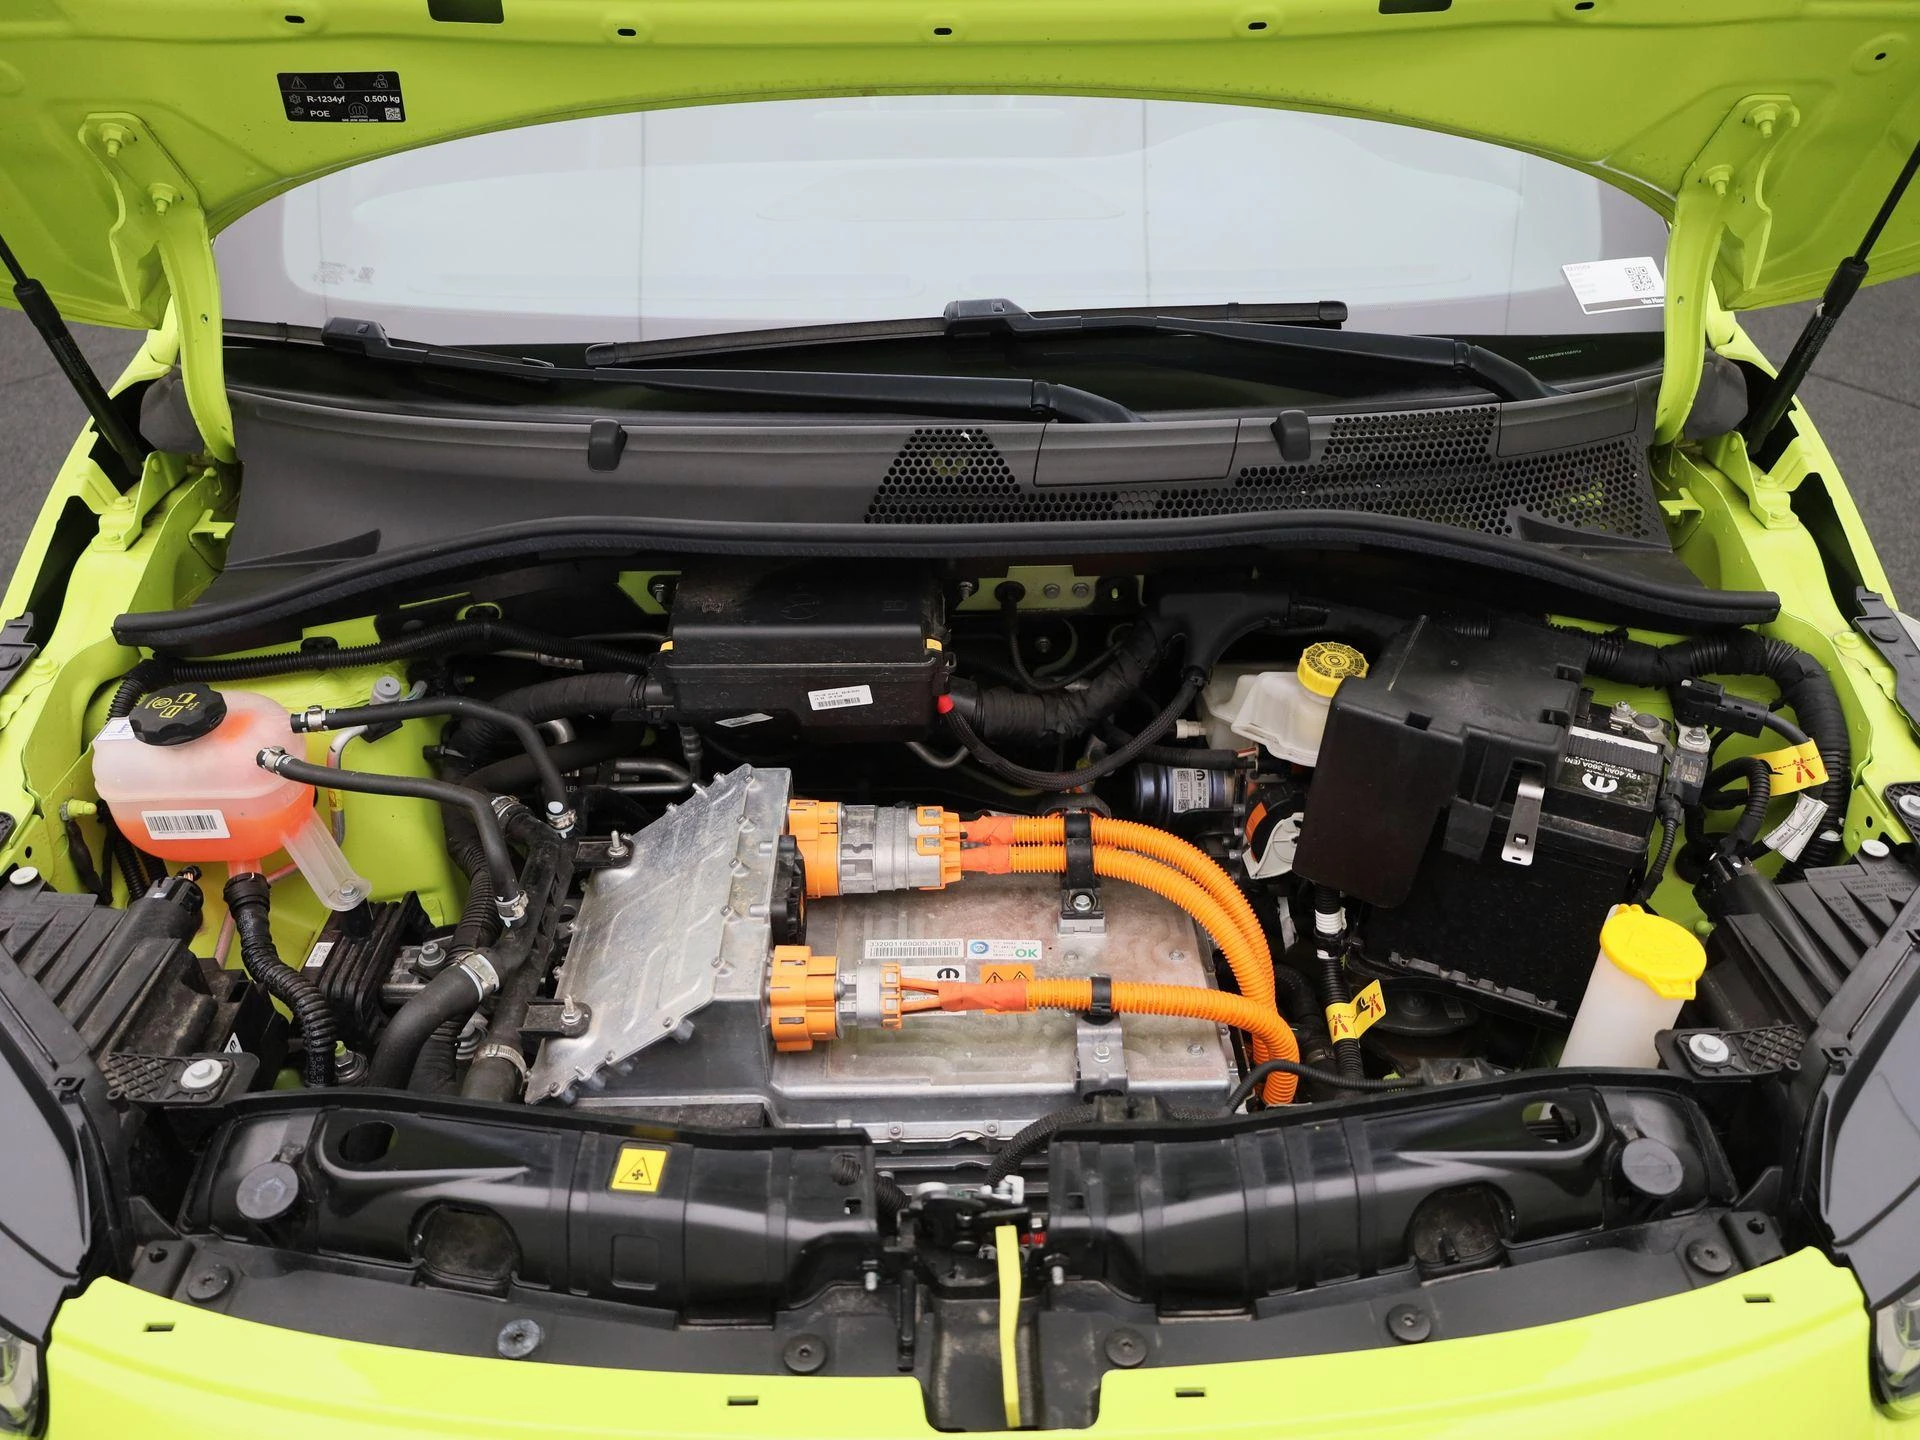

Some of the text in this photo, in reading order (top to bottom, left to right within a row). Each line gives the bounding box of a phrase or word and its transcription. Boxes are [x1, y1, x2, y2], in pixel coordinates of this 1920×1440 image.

[306, 95, 400, 104] R-1234yf 0.500 kg
[309, 110, 331, 118] POE
[1625, 772, 1641, 780] 12V
[1015, 948, 1038, 958] OK
